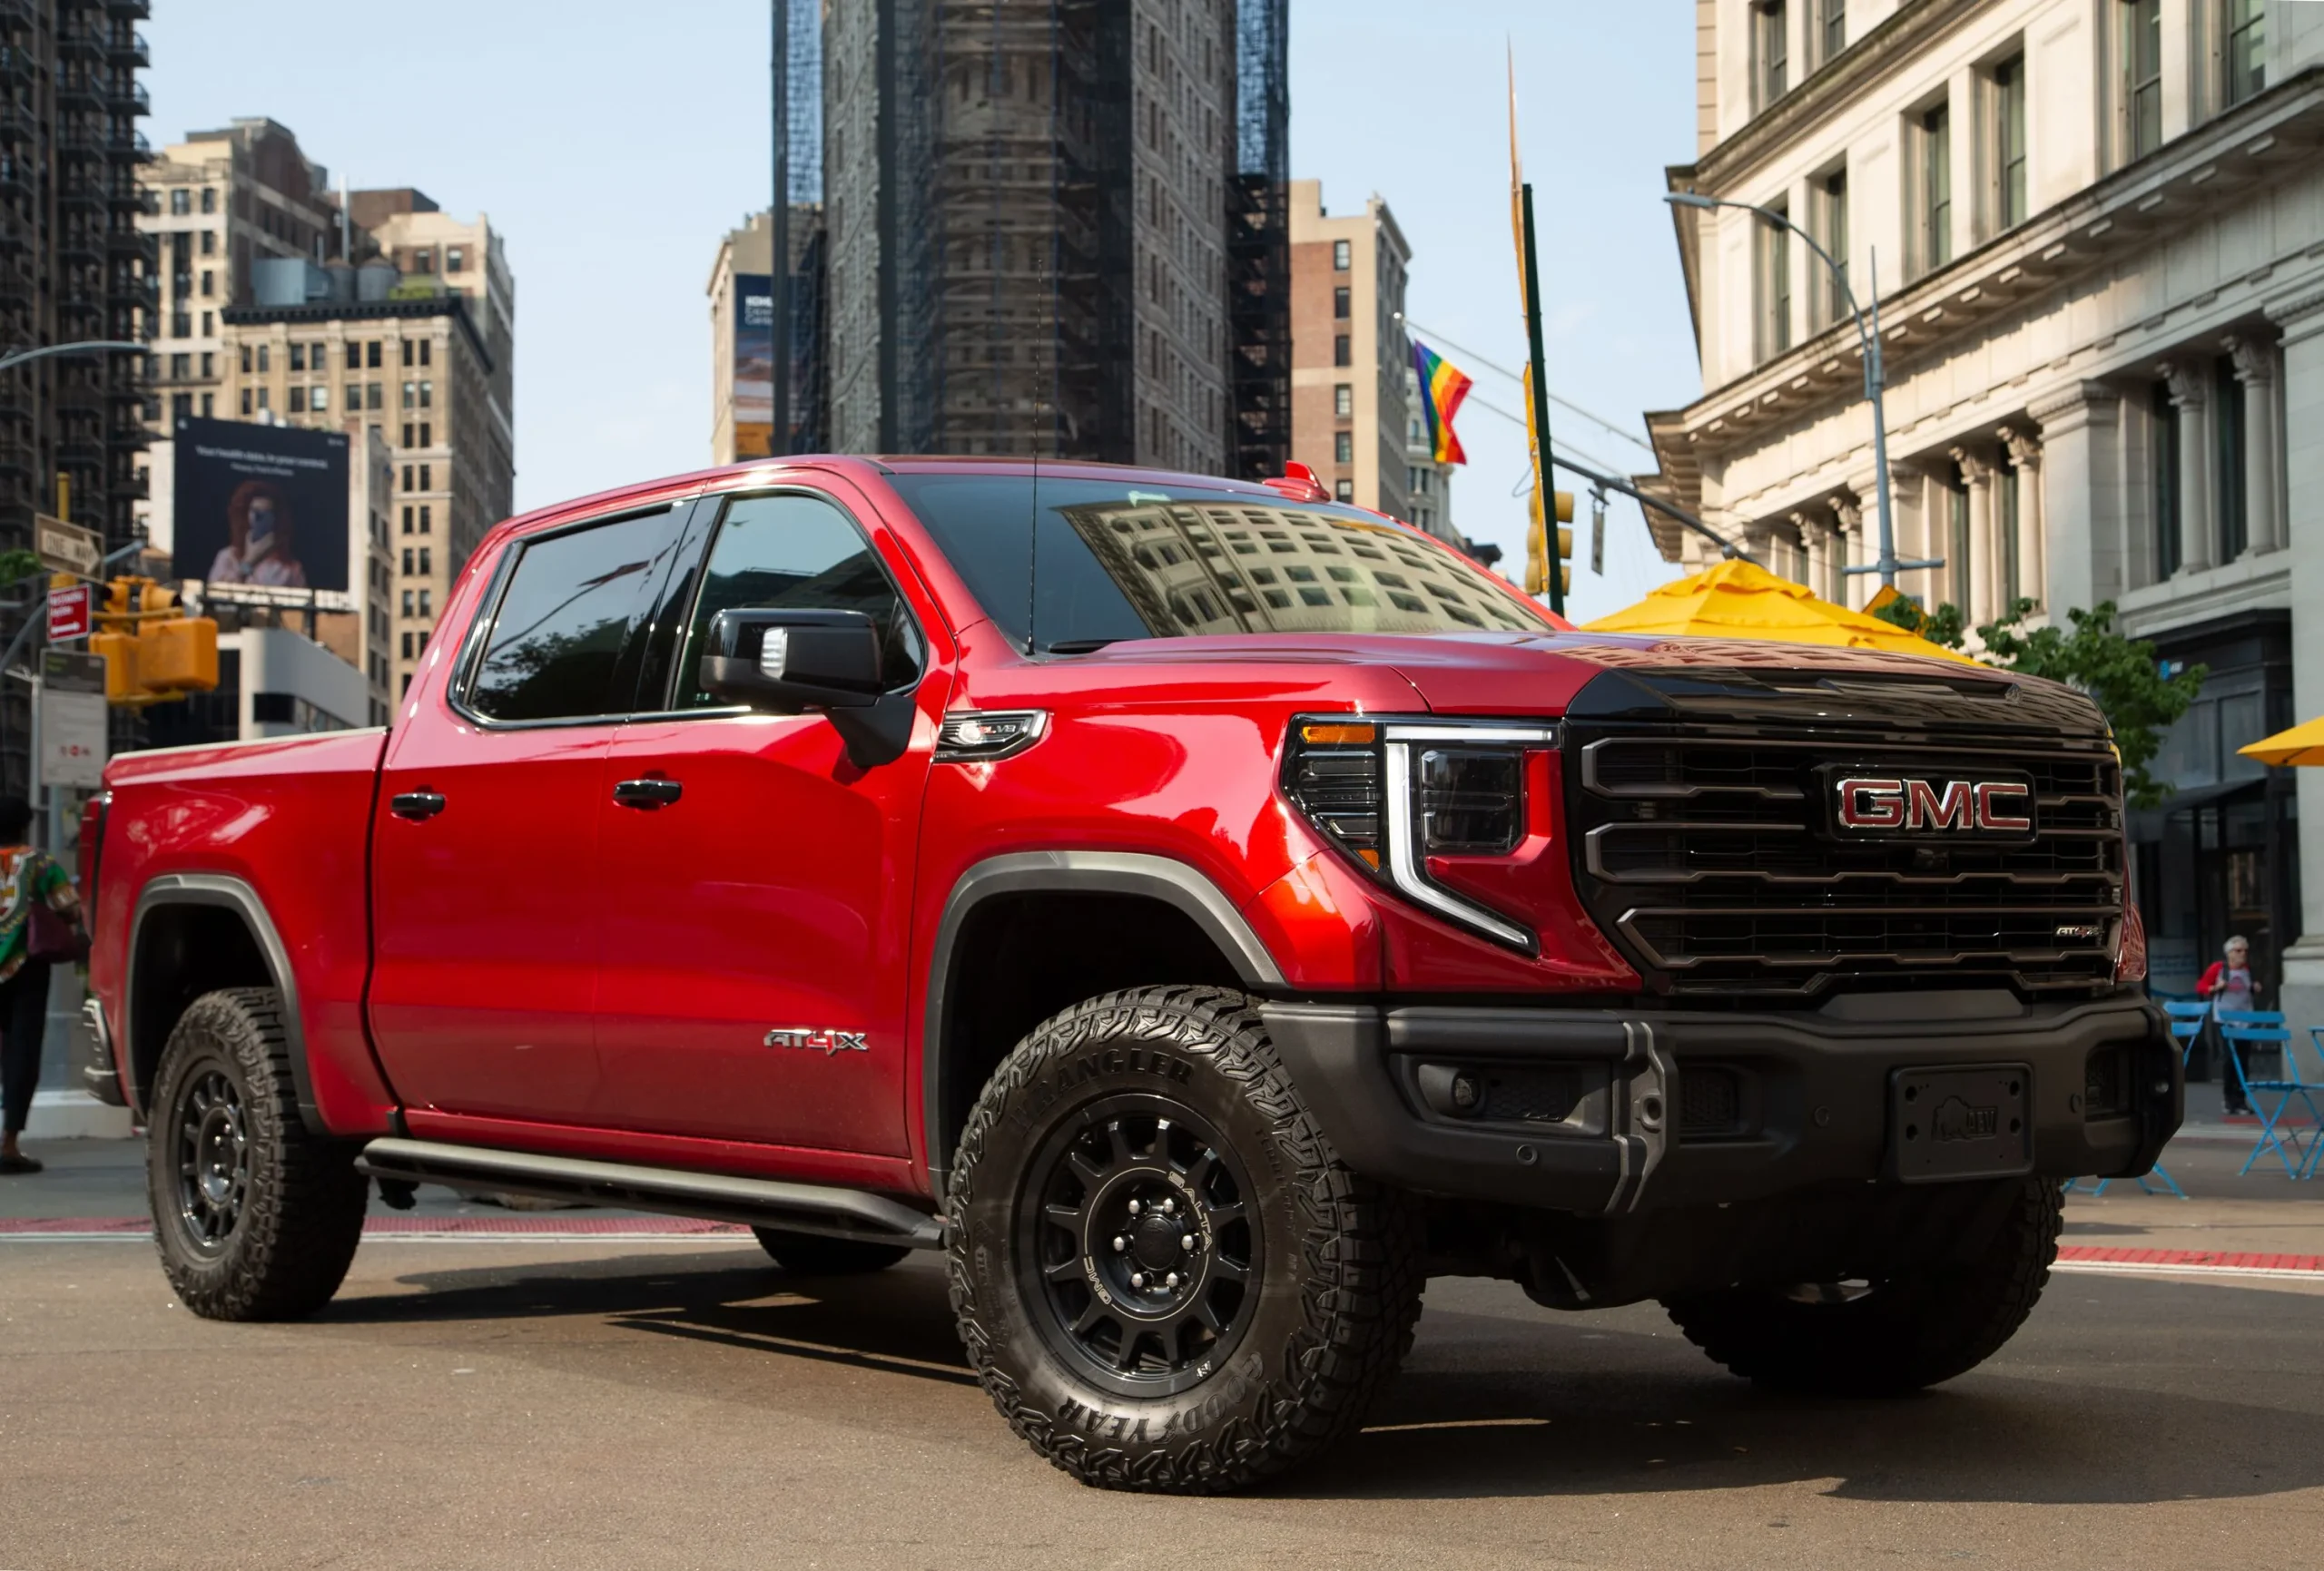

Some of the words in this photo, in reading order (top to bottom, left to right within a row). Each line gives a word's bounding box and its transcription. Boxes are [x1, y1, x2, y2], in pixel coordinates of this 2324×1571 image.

[45, 534, 66, 556] ONE
[74, 542, 93, 563] WAY
[1837, 778, 2031, 830] GMC
[763, 1028, 870, 1056] AT4X
[1009, 1047, 1195, 1139] WRANGLER
[1167, 1171, 1213, 1252] SALTA
[1083, 1256, 1112, 1305] GMC
[1058, 1351, 1264, 1445] GOODYEAR
